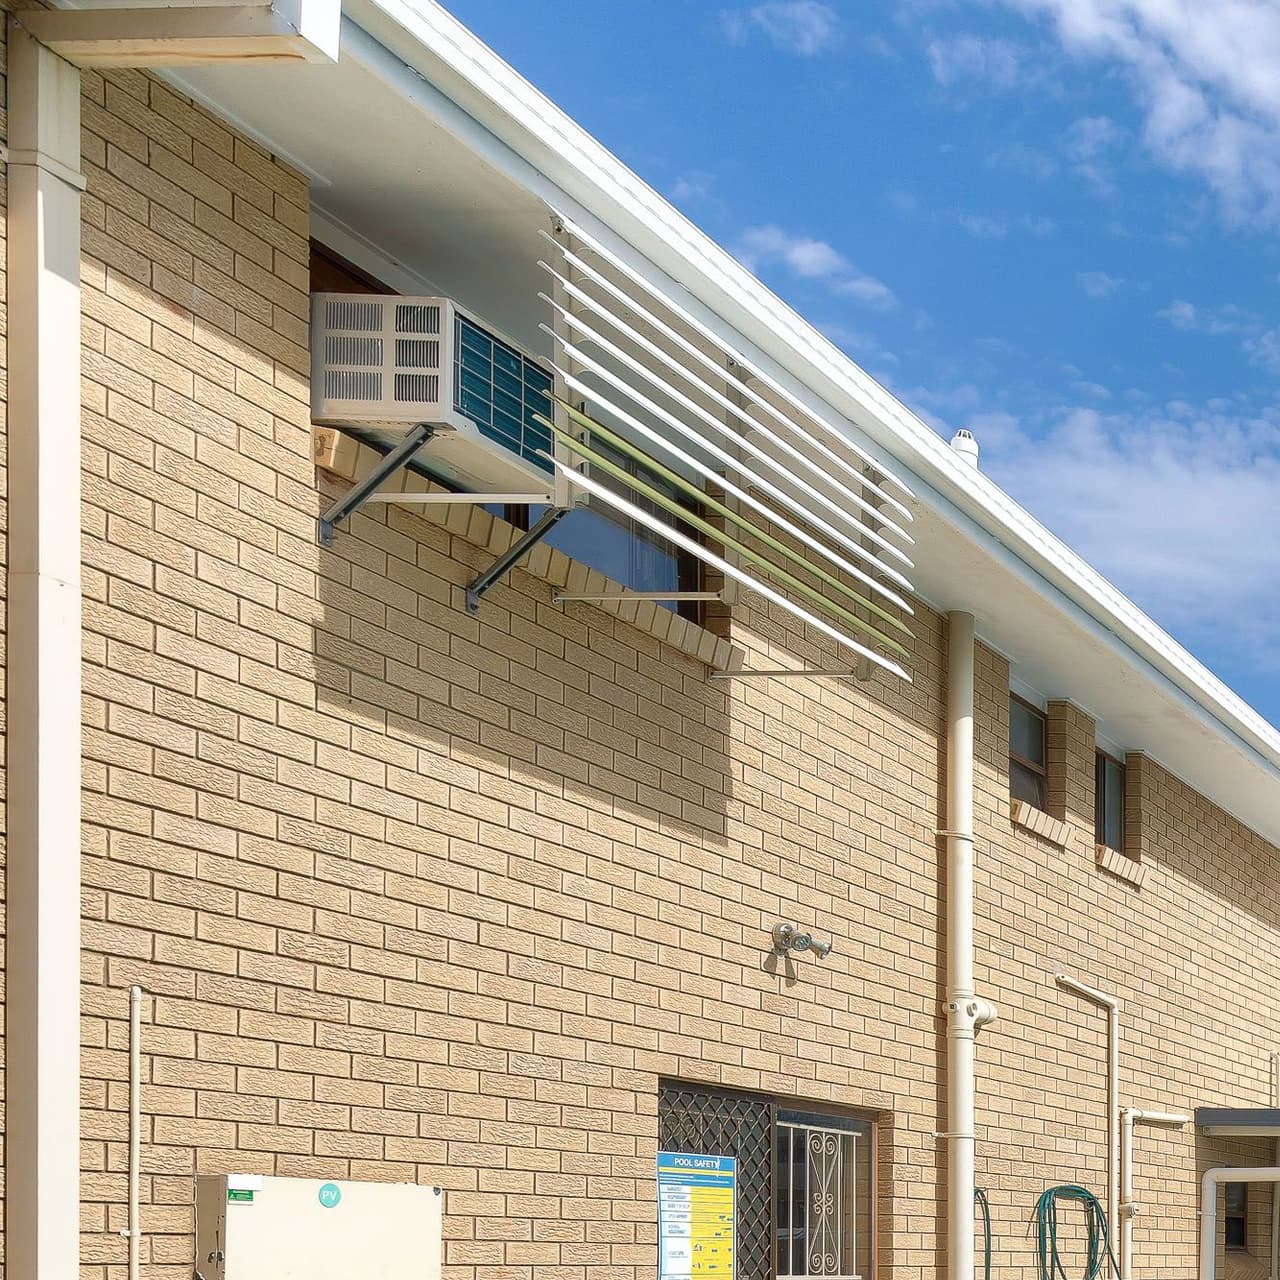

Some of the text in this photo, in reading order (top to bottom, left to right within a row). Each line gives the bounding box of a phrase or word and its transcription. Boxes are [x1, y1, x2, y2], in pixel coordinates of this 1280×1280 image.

[675, 1157, 721, 1169] POOL SAFETY
[322, 1190, 337, 1201] PV
